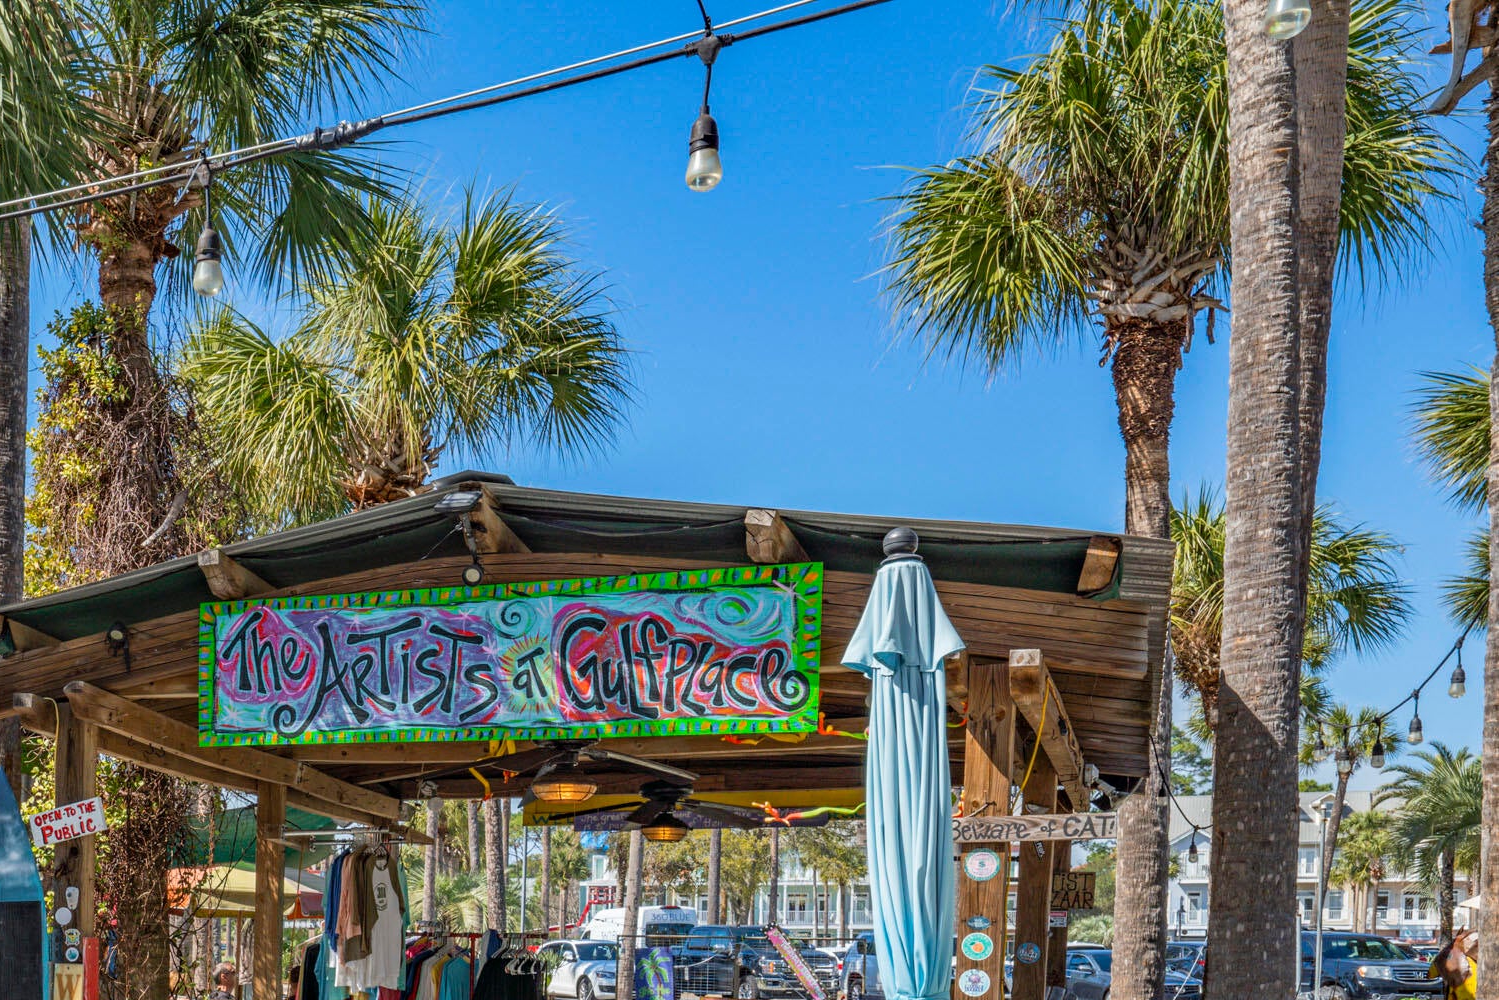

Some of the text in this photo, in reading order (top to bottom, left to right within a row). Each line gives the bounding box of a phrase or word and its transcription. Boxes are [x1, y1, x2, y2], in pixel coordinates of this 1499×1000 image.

[222, 611, 310, 695] The
[34, 800, 96, 827] OPEN TO THE
[952, 815, 1115, 841] Beware of CAT!
